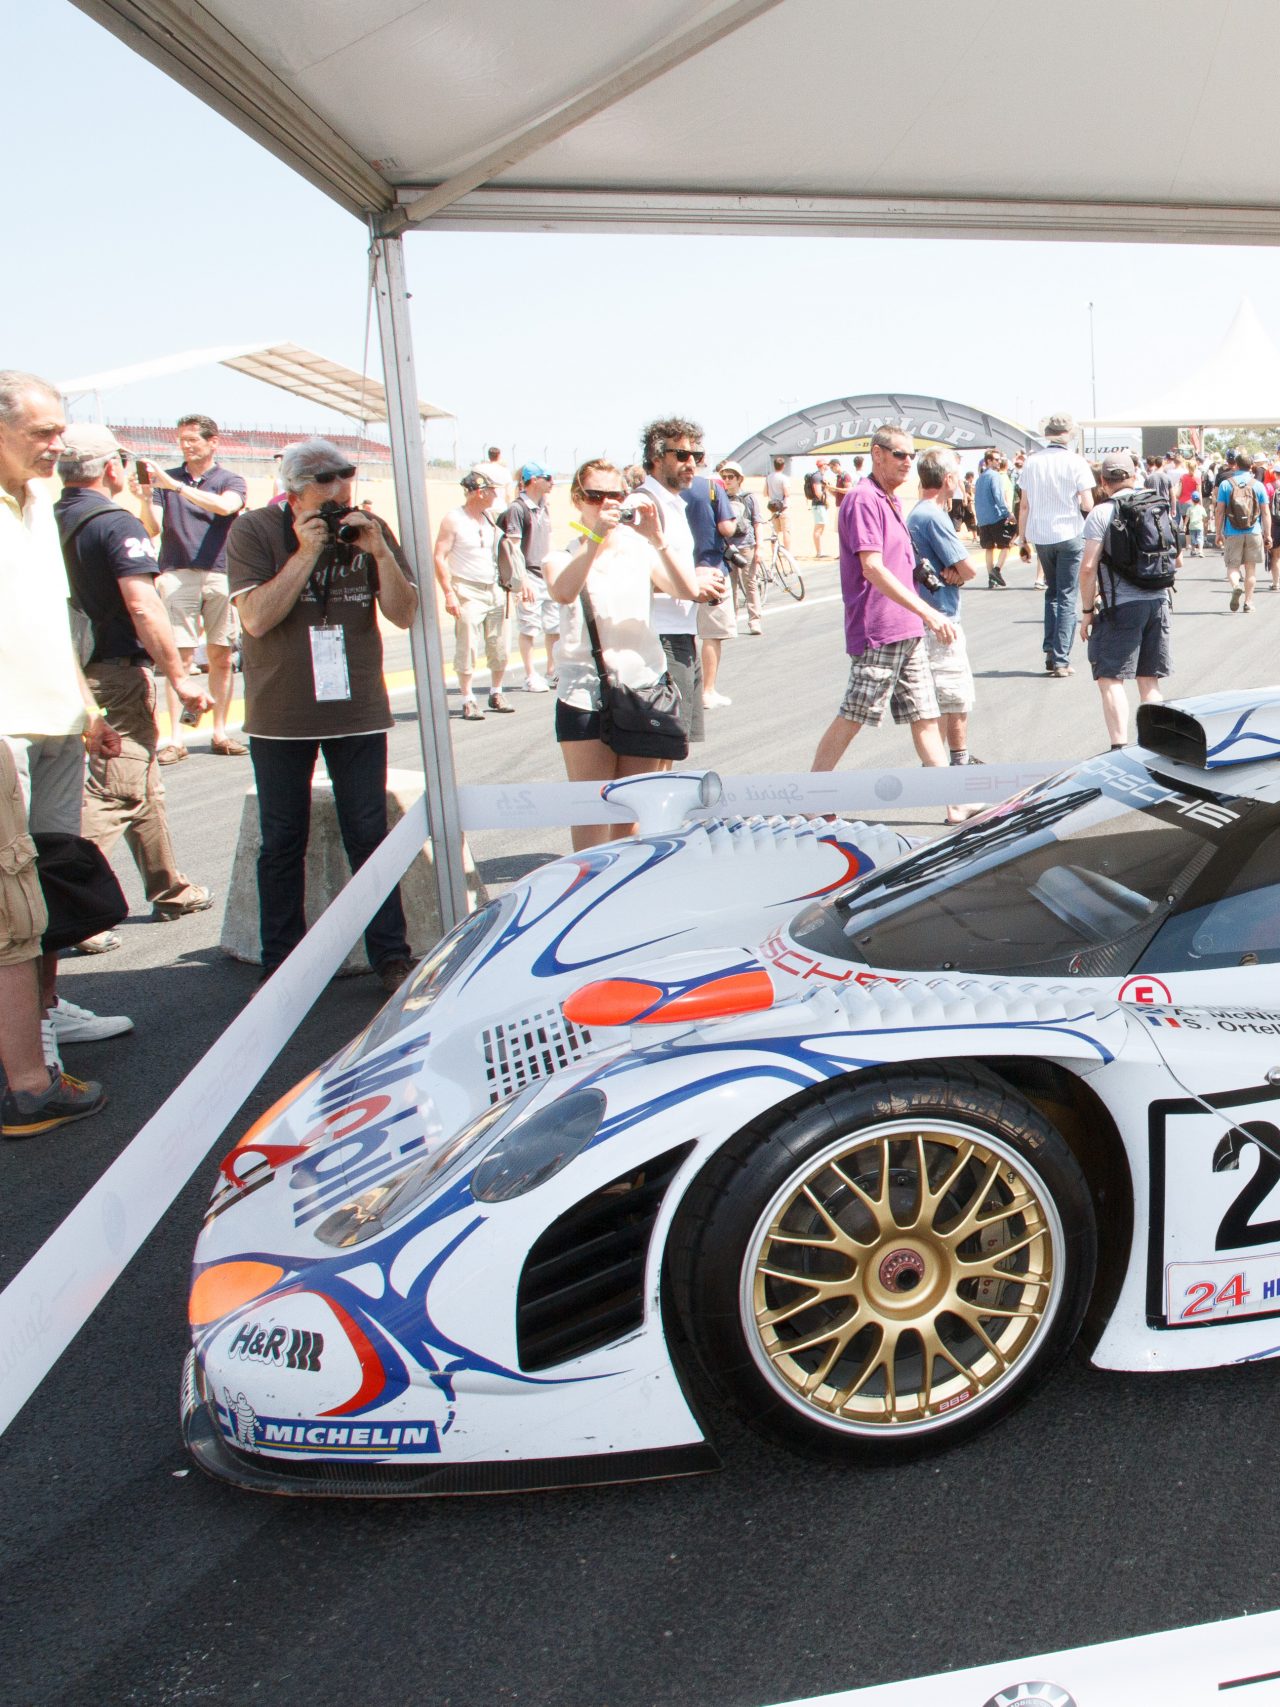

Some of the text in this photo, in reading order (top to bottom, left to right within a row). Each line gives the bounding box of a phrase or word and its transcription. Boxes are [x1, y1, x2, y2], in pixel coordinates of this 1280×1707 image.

[1182, 1017, 1210, 1032] S.
[289, 1031, 432, 1229] Mobil
[1180, 1271, 1251, 1320] 24
[231, 1322, 288, 1361] H&R
[939, 1391, 970, 1411] BBS
[264, 1423, 430, 1445] MICHELIN
